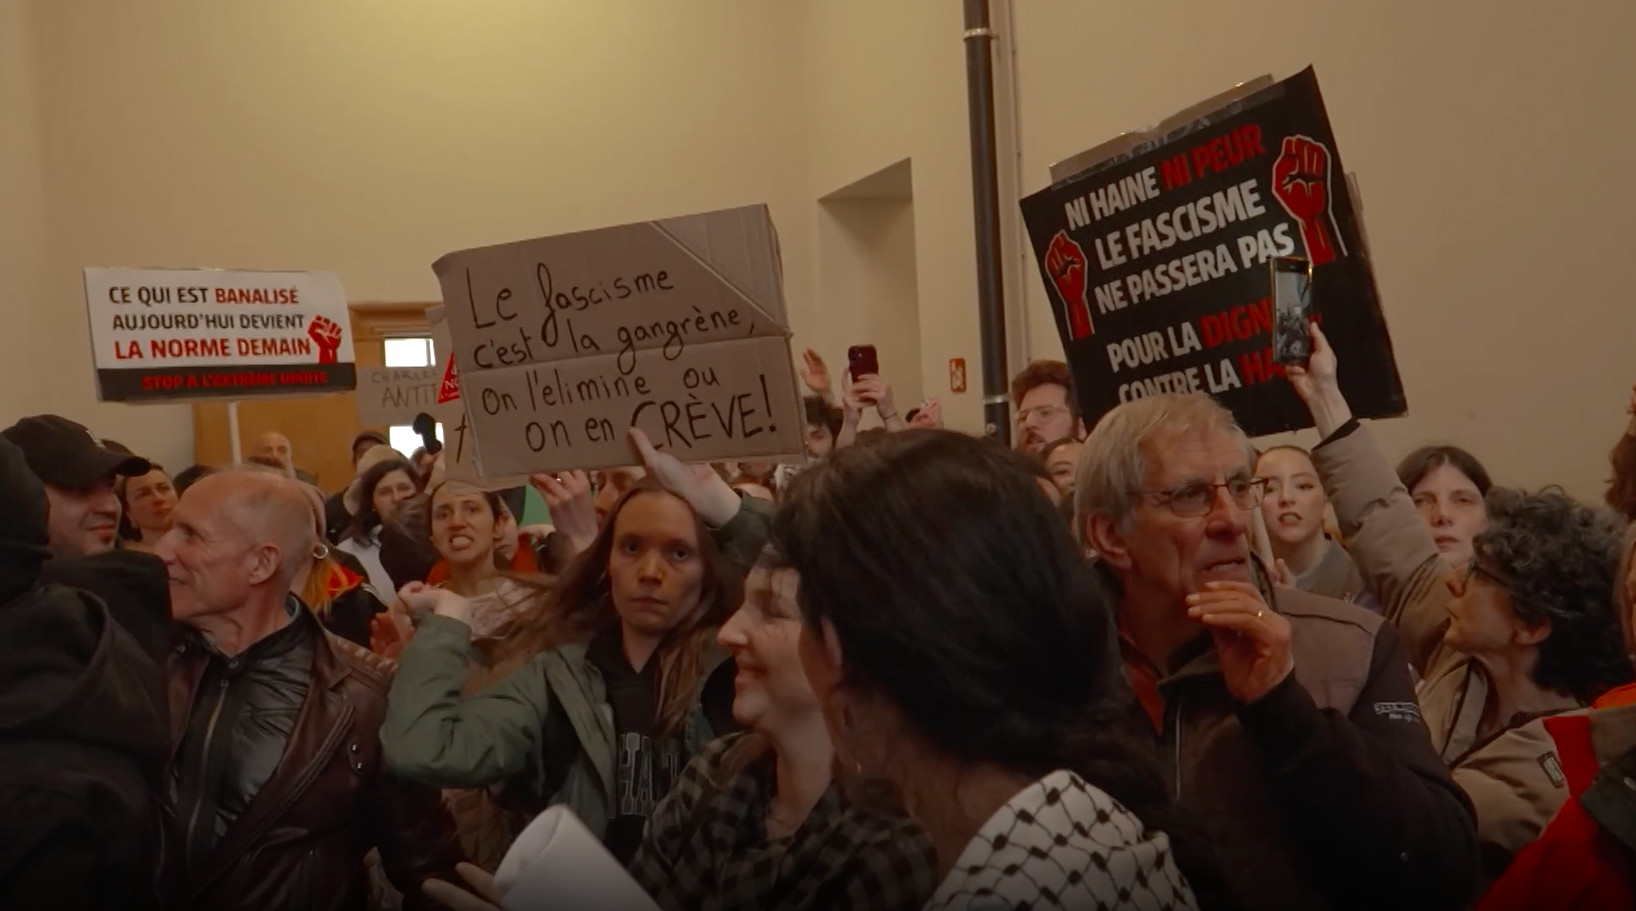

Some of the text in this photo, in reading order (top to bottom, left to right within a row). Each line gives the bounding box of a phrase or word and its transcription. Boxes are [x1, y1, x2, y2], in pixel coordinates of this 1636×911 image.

[1064, 123, 1266, 231] NI HAINE NI PEUR
[1095, 178, 1266, 271] LE FASCISME
[1094, 222, 1295, 315] NE PASSERA PAS
[109, 285, 299, 307] CE QUI EST BANALISÉ
[466, 262, 674, 347] Le fascisme
[112, 313, 304, 331] AUJOURD'HUI DEVIENT
[474, 305, 755, 375] c'est la gangrène,
[1106, 297, 1321, 373] POUR LA DIGN
[114, 338, 311, 359] LA NORME DEMAIN
[142, 375, 184, 391] STOP
[279, 370, 328, 385] DROITE
[683, 366, 720, 390] ou
[1204, 358, 1242, 394] LA
[585, 417, 616, 442] en
